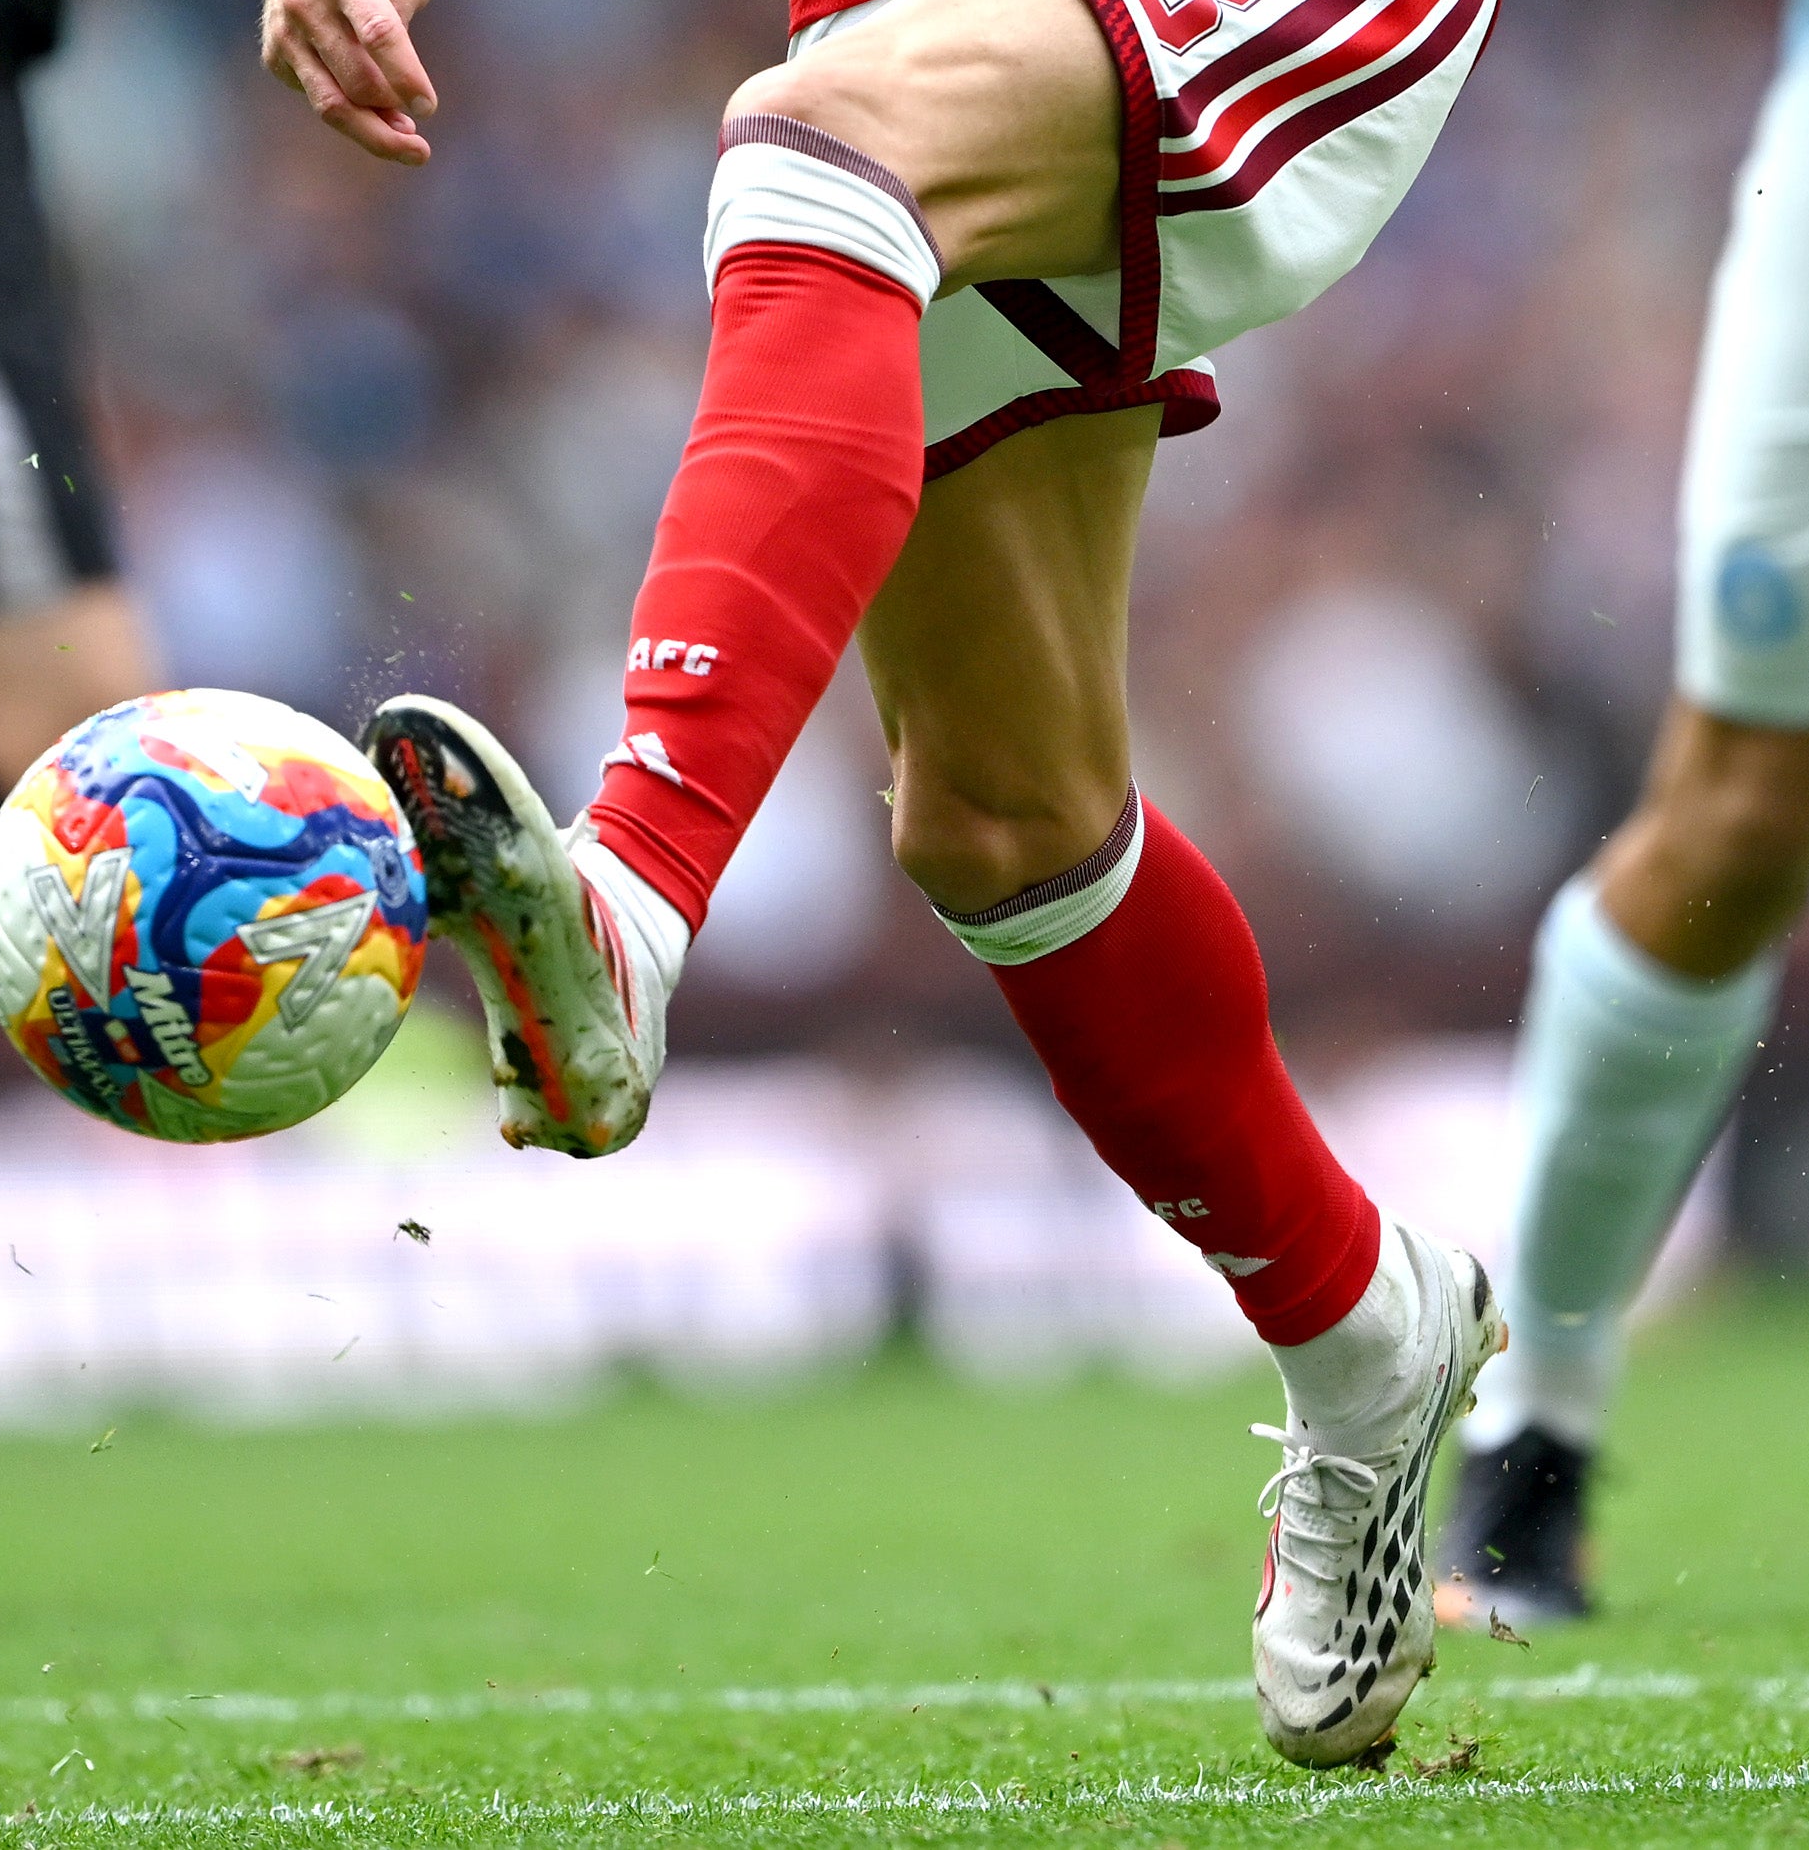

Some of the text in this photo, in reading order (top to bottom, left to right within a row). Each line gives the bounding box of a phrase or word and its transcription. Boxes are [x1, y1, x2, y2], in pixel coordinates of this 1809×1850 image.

[628, 637, 719, 676] AFC
[48, 986, 117, 1096] ULTIMAX
[123, 963, 213, 1088] Mitre
